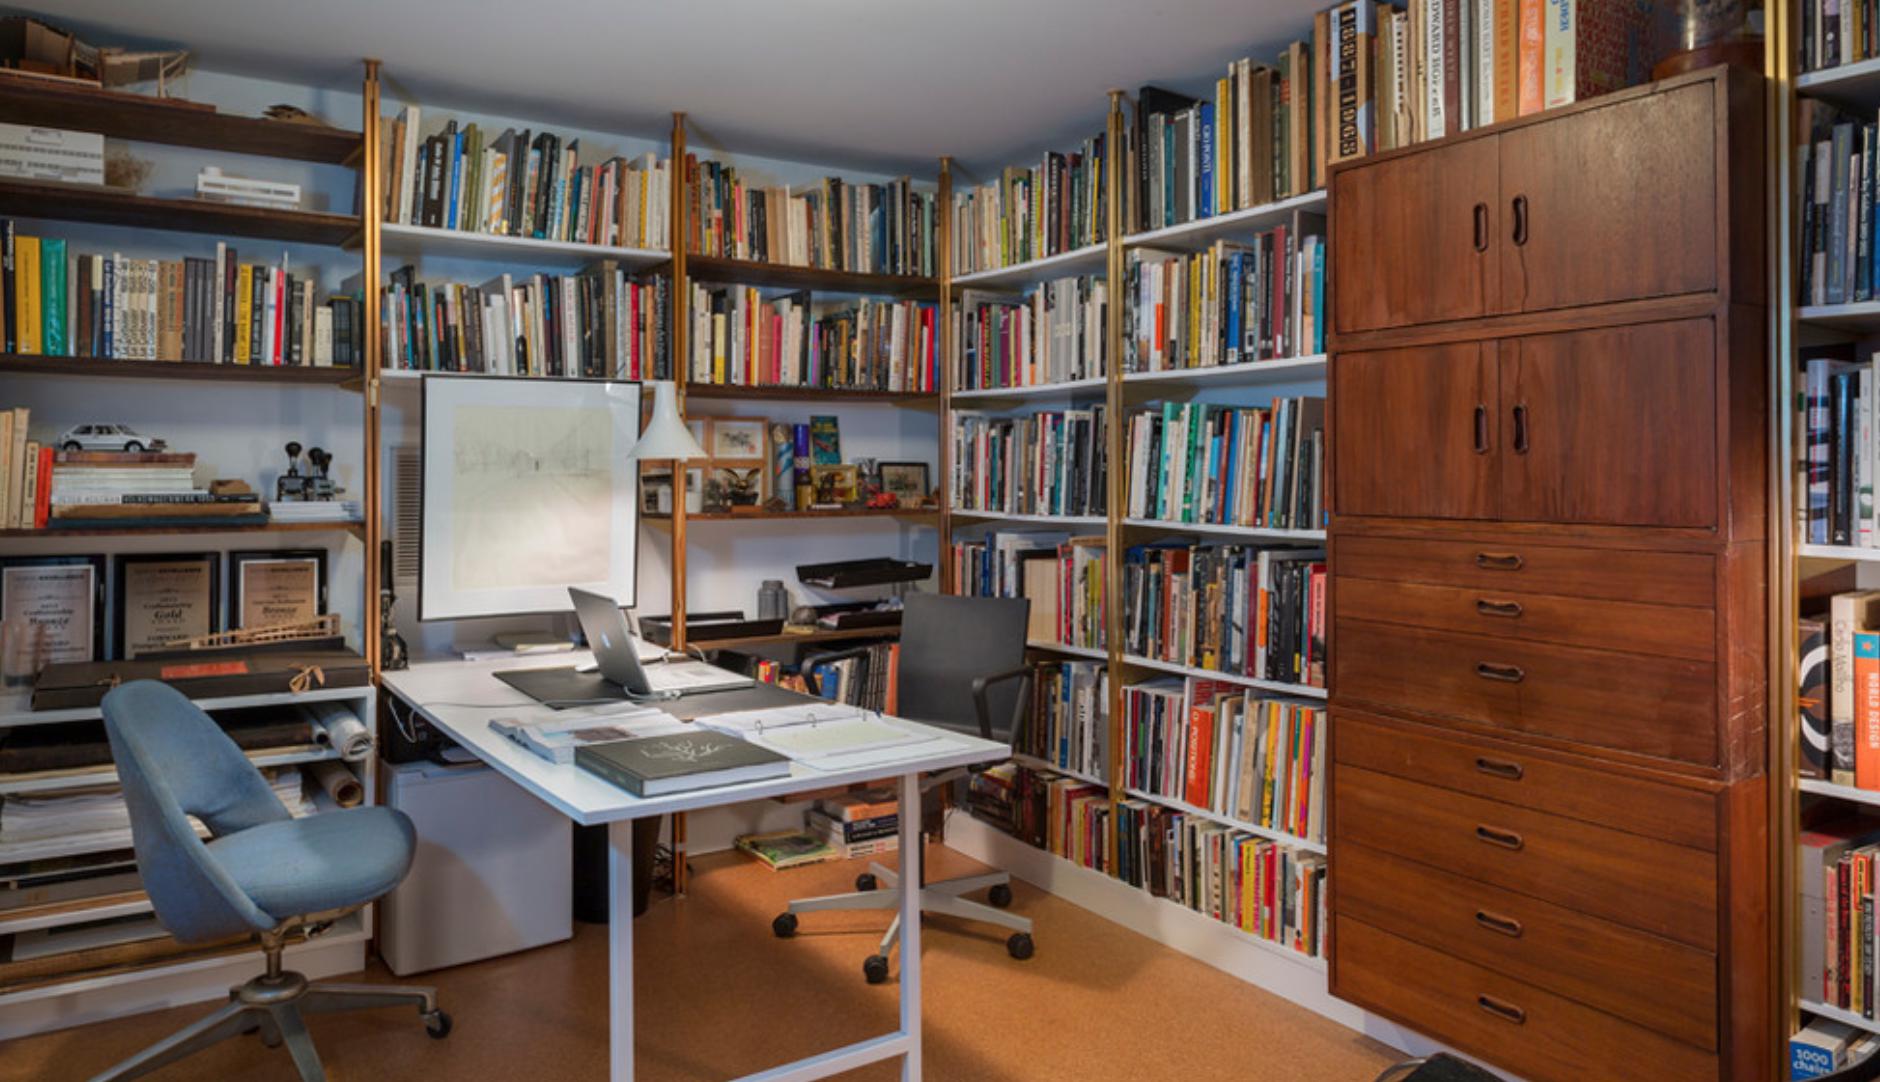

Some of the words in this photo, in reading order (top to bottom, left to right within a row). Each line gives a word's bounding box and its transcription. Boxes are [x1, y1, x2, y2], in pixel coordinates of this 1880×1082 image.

[1431, 0, 1441, 54] DWARD
[1835, 619, 1848, 651] Carlo
[1868, 673, 1879, 708] WORLD
[1869, 711, 1879, 749] DESIGN
[1796, 1049, 1829, 1066] 1000
